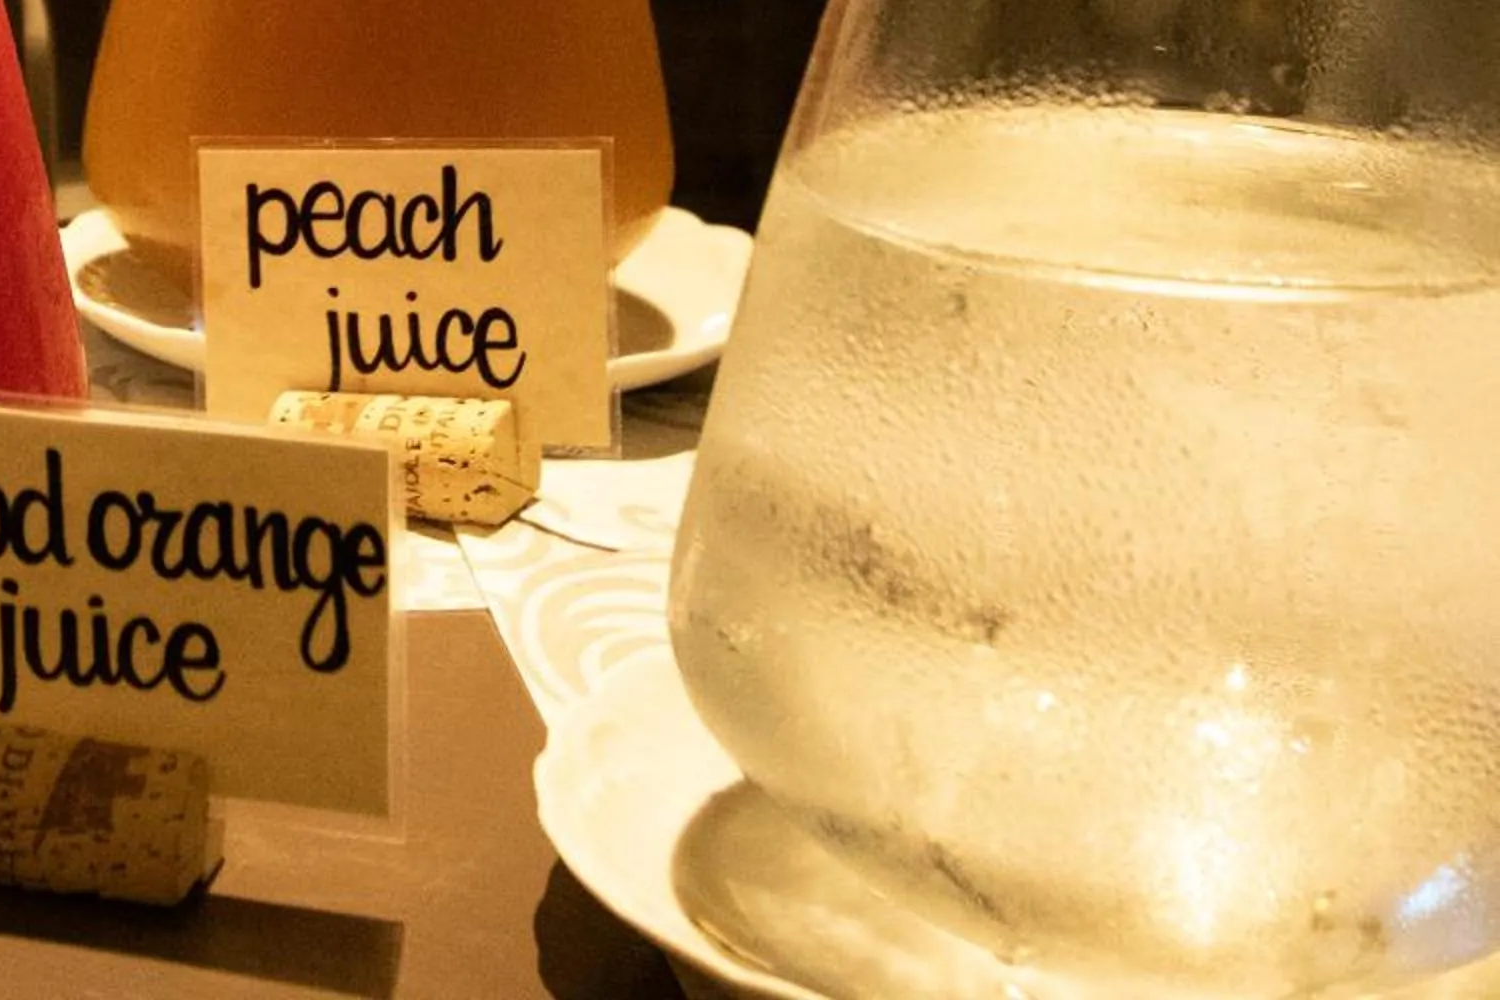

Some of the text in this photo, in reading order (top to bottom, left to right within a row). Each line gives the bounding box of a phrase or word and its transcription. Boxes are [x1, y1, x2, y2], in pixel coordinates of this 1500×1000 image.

[246, 164, 503, 289] peach
[325, 286, 526, 393] juice
[85, 490, 387, 675] orange
